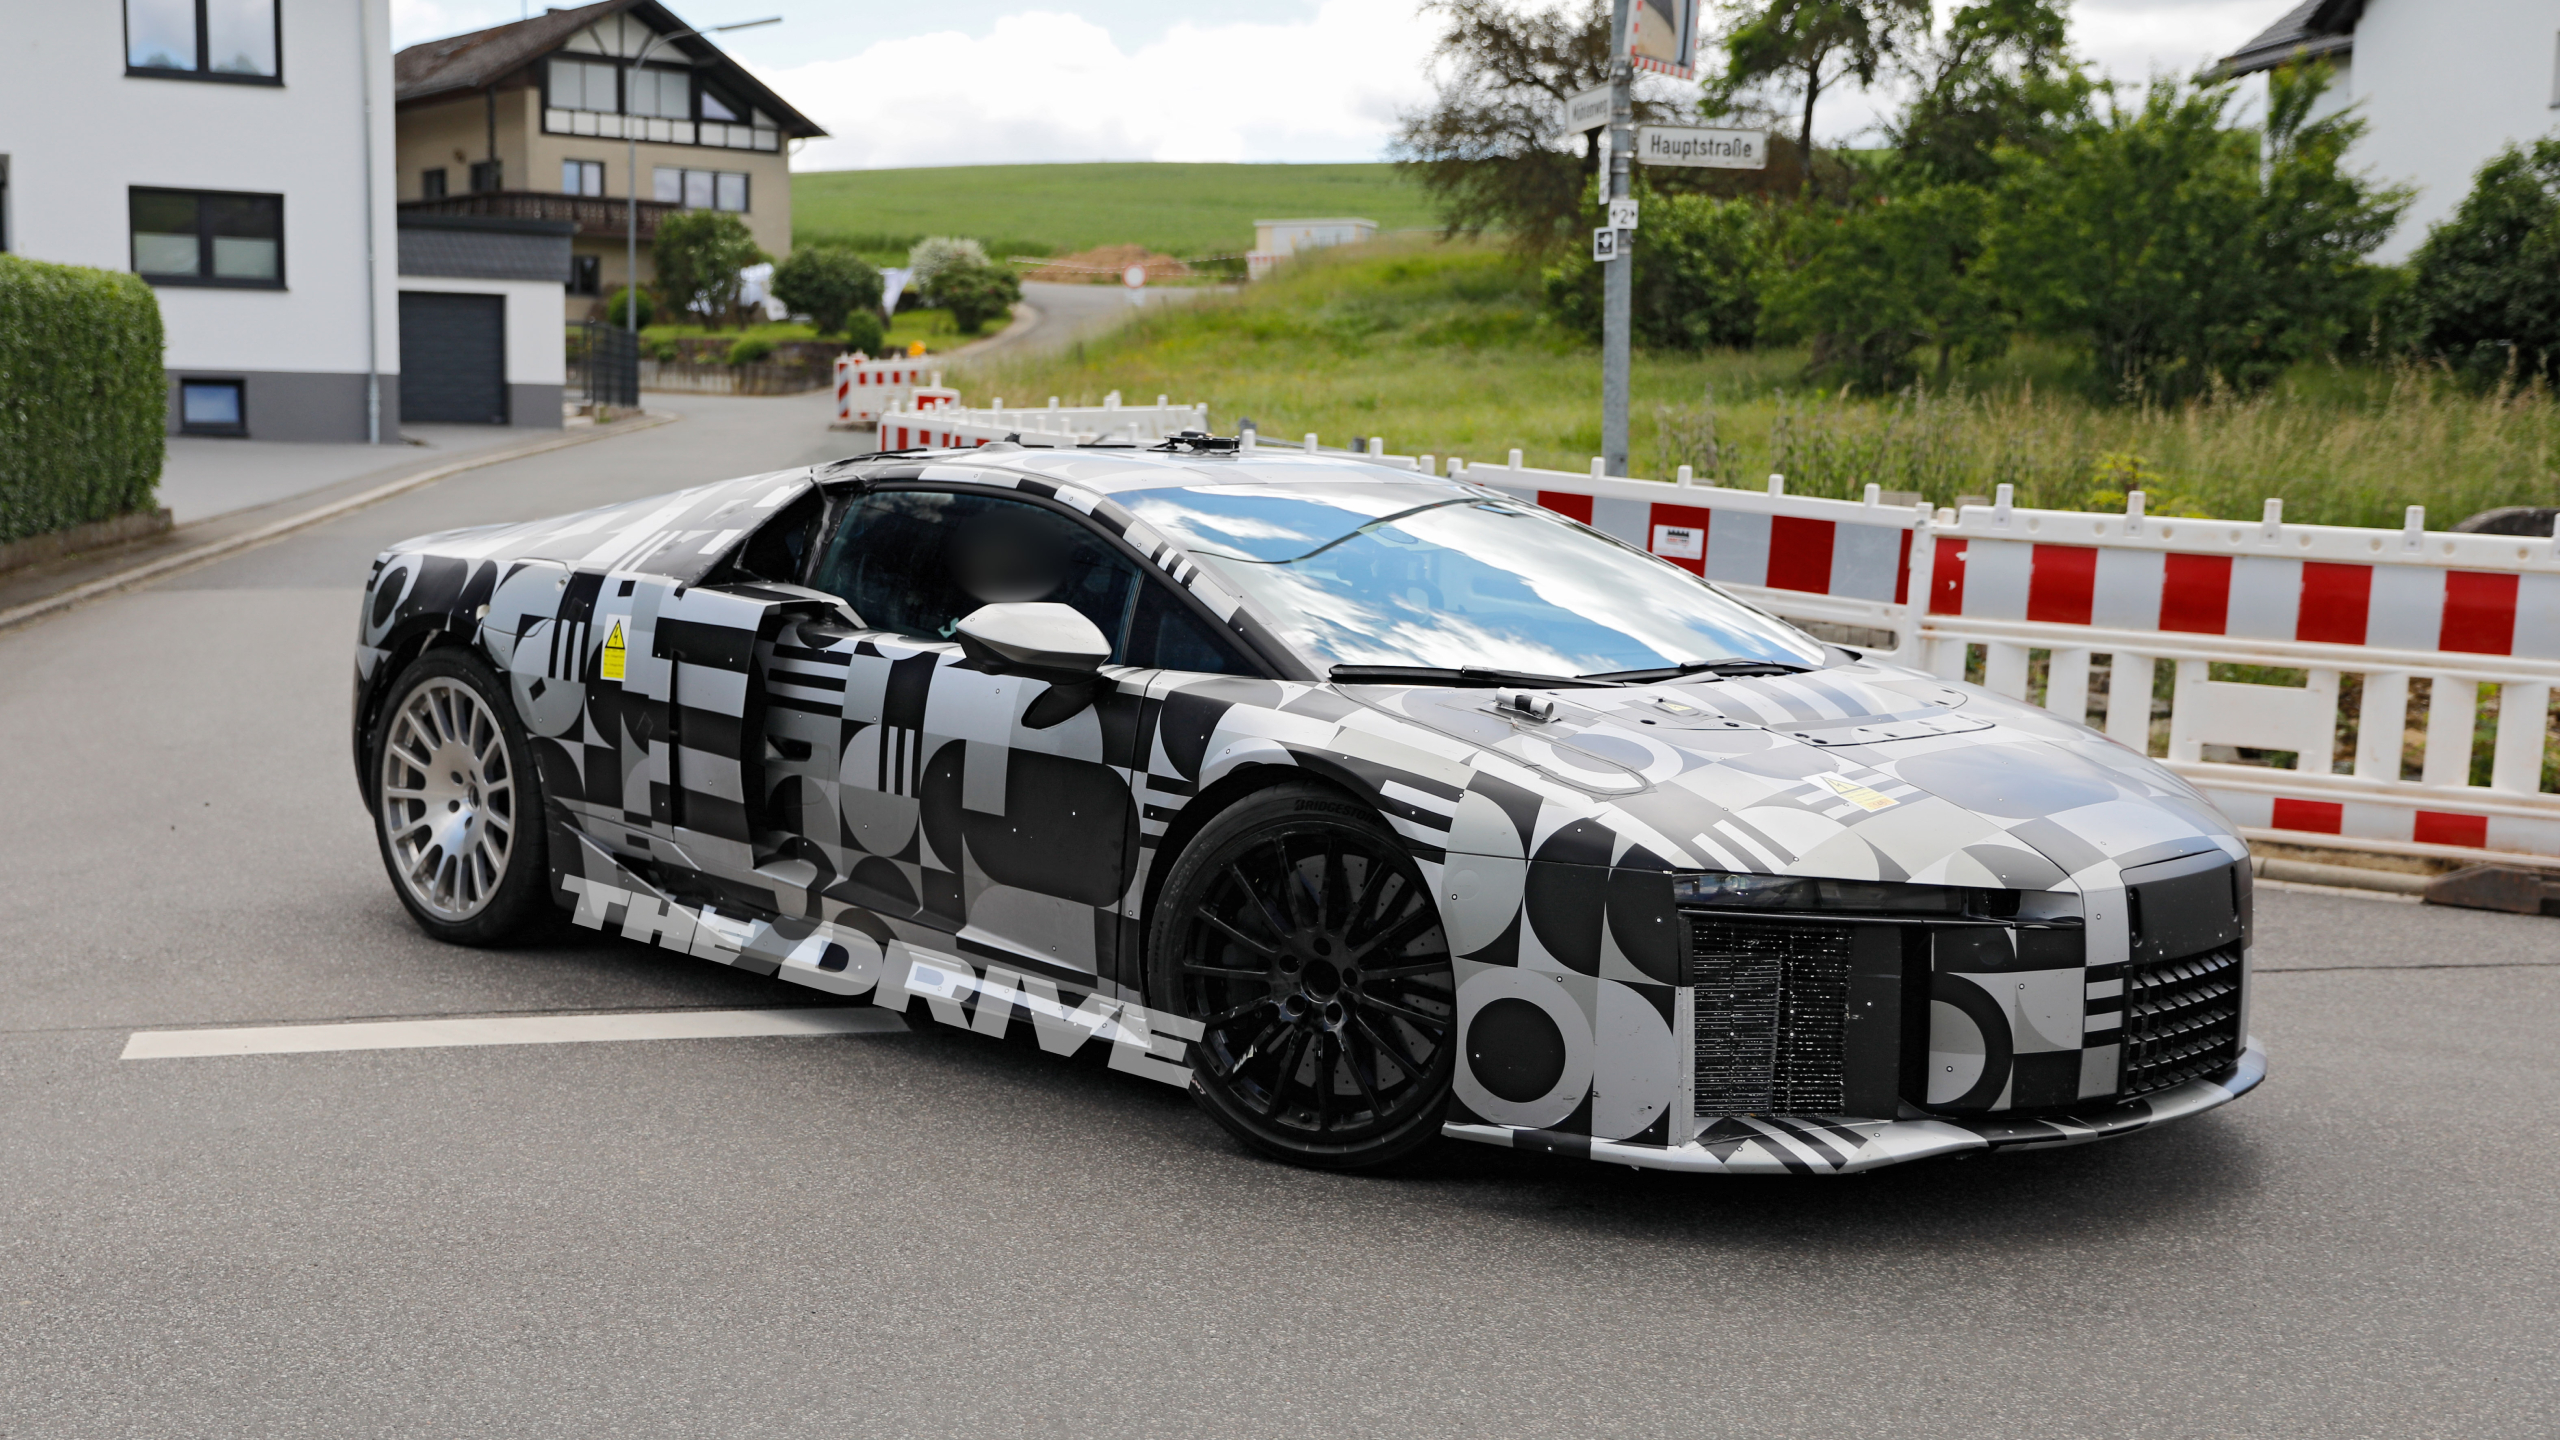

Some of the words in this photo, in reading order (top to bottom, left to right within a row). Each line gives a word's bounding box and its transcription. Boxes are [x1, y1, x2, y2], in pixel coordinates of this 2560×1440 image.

[1650, 134, 1752, 160] Hauptstraße
[1619, 208, 1629, 224] 2
[1294, 799, 1383, 827] BRIDGESTONE
